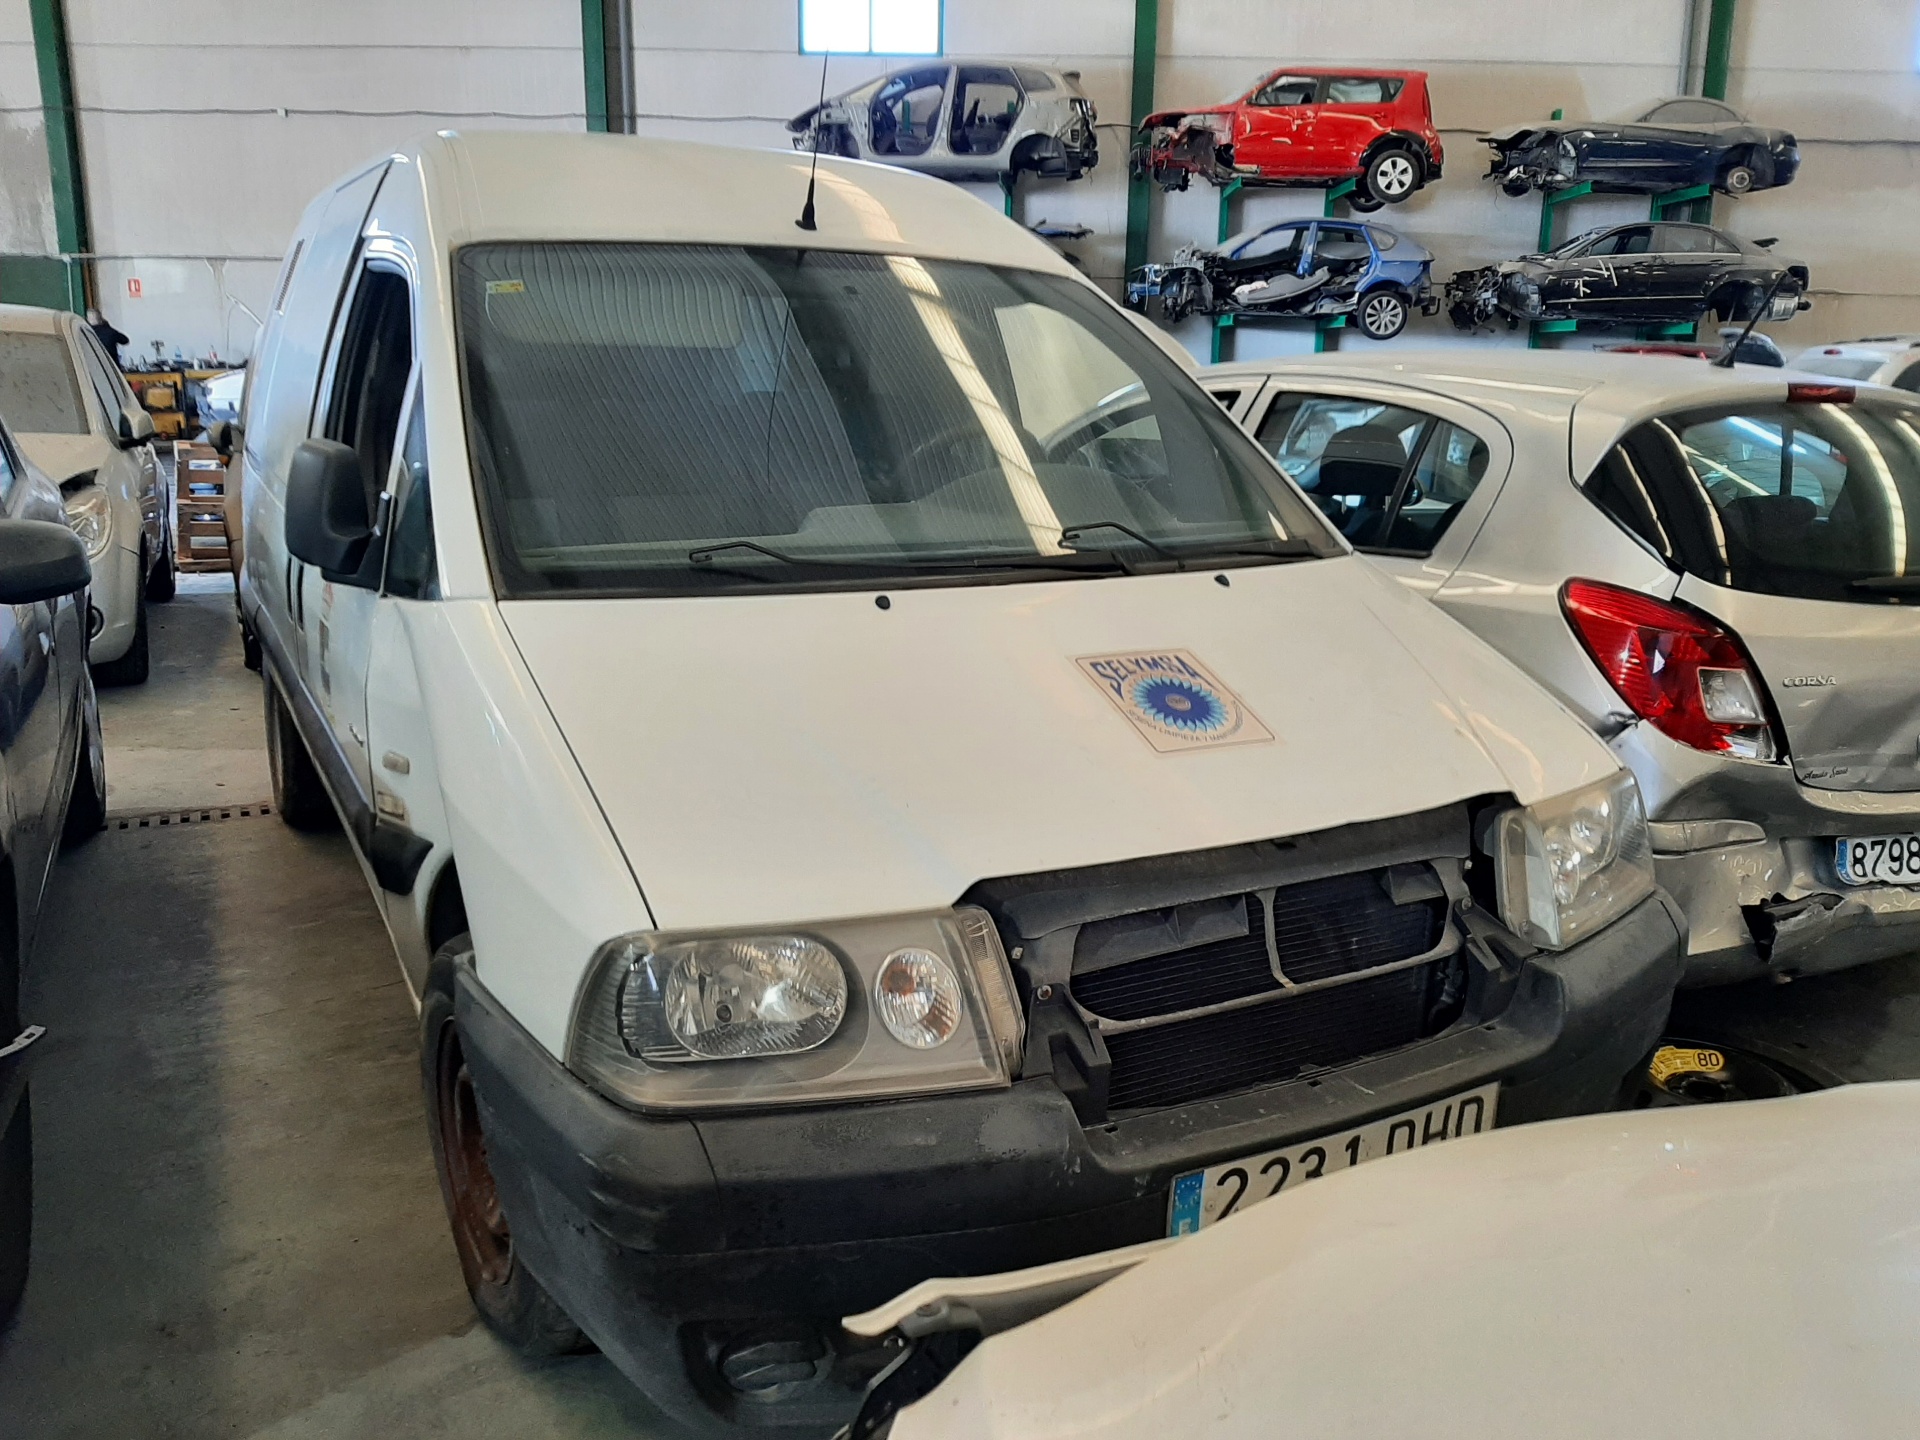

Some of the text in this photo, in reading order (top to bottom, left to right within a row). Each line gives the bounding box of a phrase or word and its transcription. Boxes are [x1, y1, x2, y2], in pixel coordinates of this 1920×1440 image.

[1782, 675, 1837, 688] CORSA
[1852, 836, 1920, 878] 8798
[1697, 1052, 1720, 1067] 80
